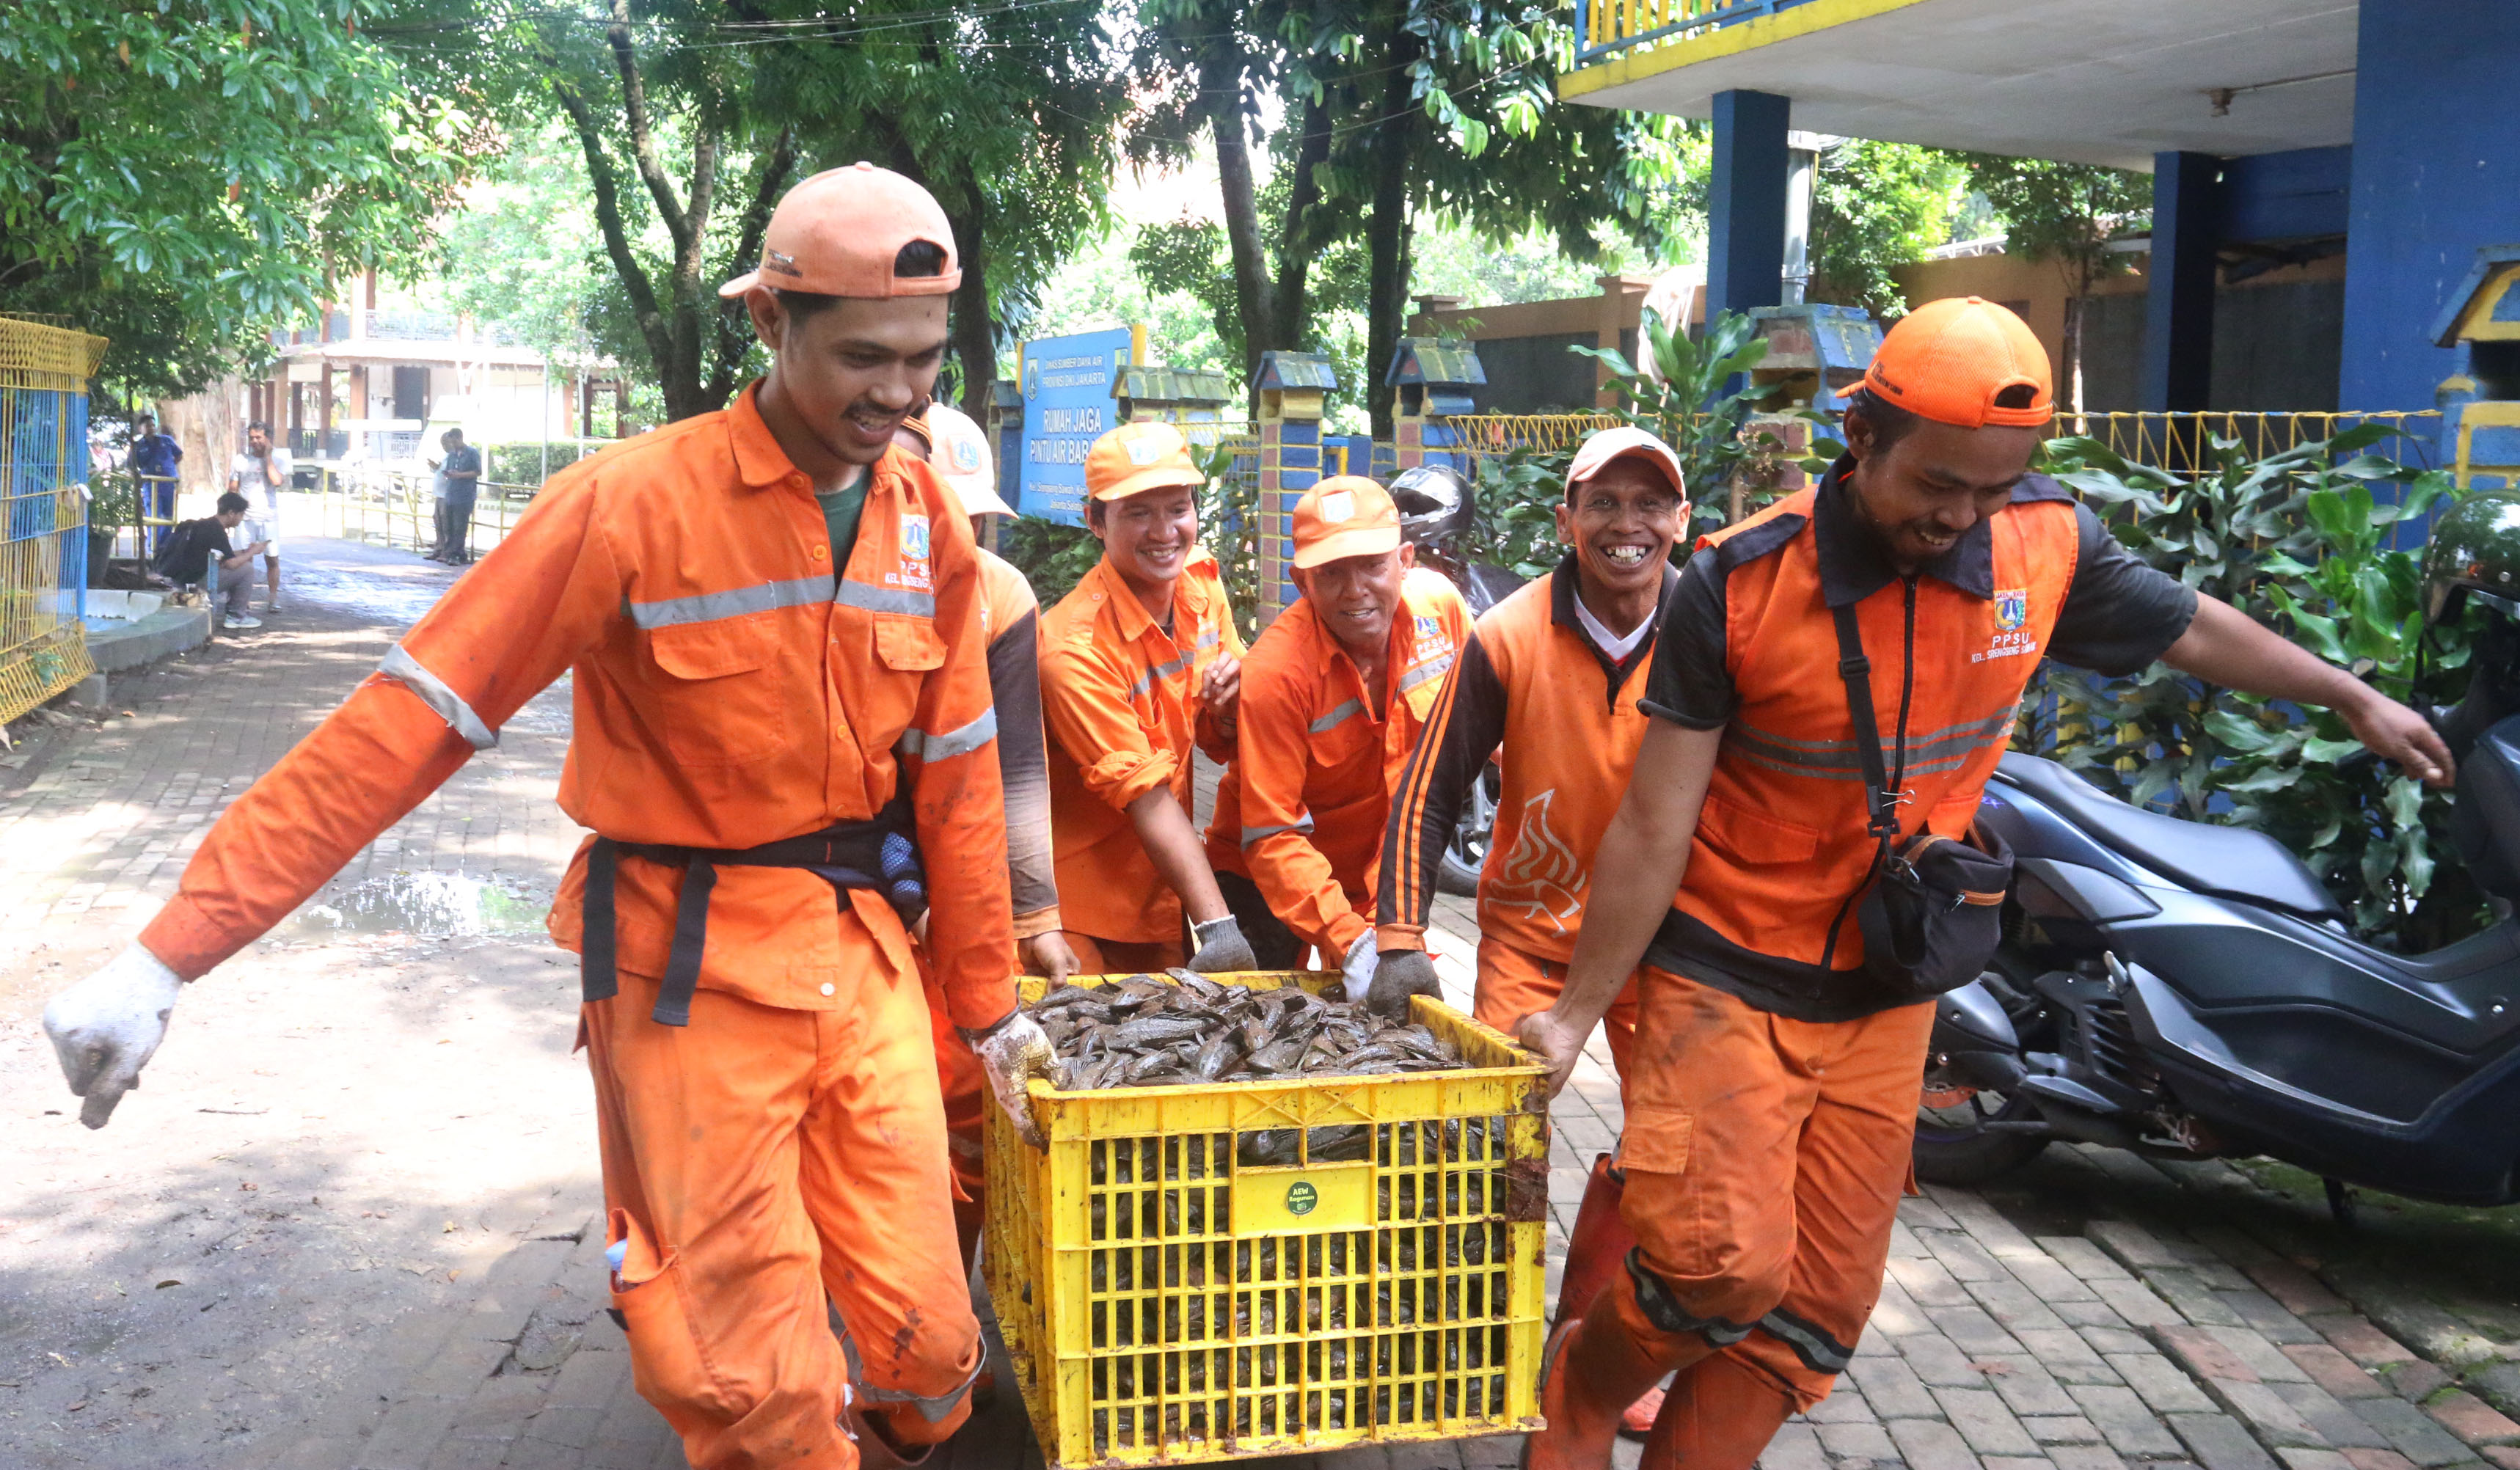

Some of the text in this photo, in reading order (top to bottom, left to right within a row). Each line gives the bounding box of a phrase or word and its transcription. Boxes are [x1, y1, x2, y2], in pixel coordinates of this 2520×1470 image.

[1092, 355, 1103, 367] AIR
[1075, 372, 1106, 386] JAKARTA
[1044, 406, 1102, 433] RUMAH JAGA
[1029, 439, 1094, 464] PINTU AIR BAB
[1992, 632, 2030, 648] PPSU
[1987, 646, 2020, 659] SRENGSENG
[1293, 1187, 1308, 1196] AEW
